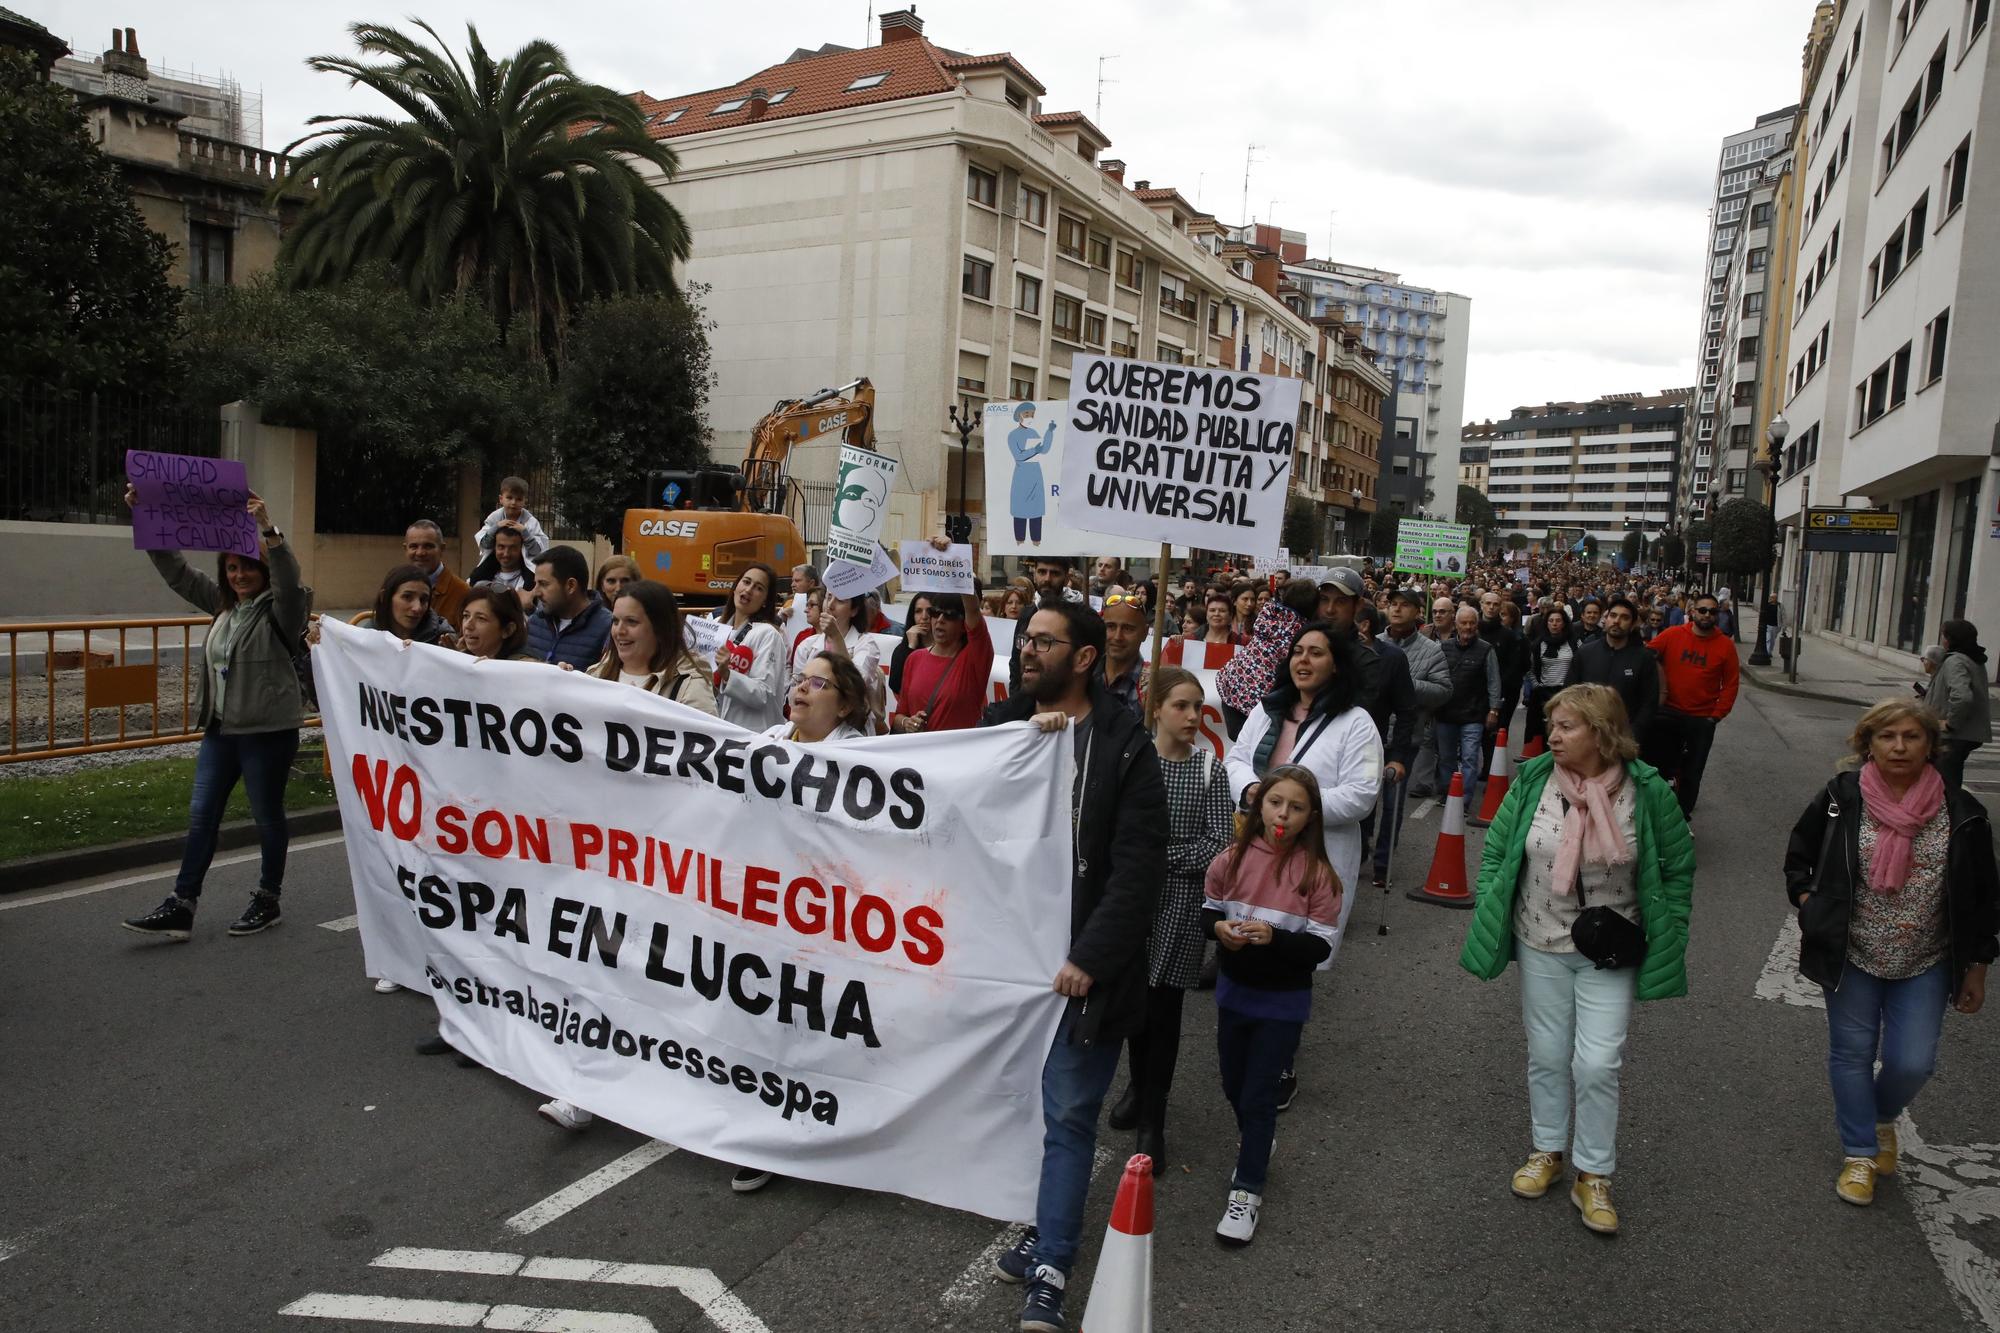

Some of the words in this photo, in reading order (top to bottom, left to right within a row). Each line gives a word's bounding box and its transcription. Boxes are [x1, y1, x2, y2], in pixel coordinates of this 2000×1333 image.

[1086, 360, 1261, 412] QUEREMOS
[818, 411, 848, 432] CASE
[1072, 398, 1188, 442] SANIDAD
[1195, 412, 1294, 455] PUBLICA
[130, 453, 217, 484] SANIDAD
[1096, 438, 1253, 489] GRATUITA
[1261, 458, 1288, 491] Y
[1087, 473, 1256, 528] UNIVERSAL
[176, 526, 255, 554] CALIDAD
[639, 519, 699, 538] CASE
[838, 540, 872, 555] ESTUDIO
[910, 557, 937, 565] LUEGO
[903, 567, 920, 576] QUE
[922, 568, 950, 578] SOMOS
[1680, 649, 1707, 666] HH
[359, 682, 583, 763] NUESTROS
[604, 721, 926, 830] DERECHOS
[352, 753, 422, 842] NO
[435, 805, 551, 864] SON
[571, 823, 944, 966] PRIVILEGIOS
[547, 896, 628, 969] EN
[645, 922, 881, 1049] LUCHA
